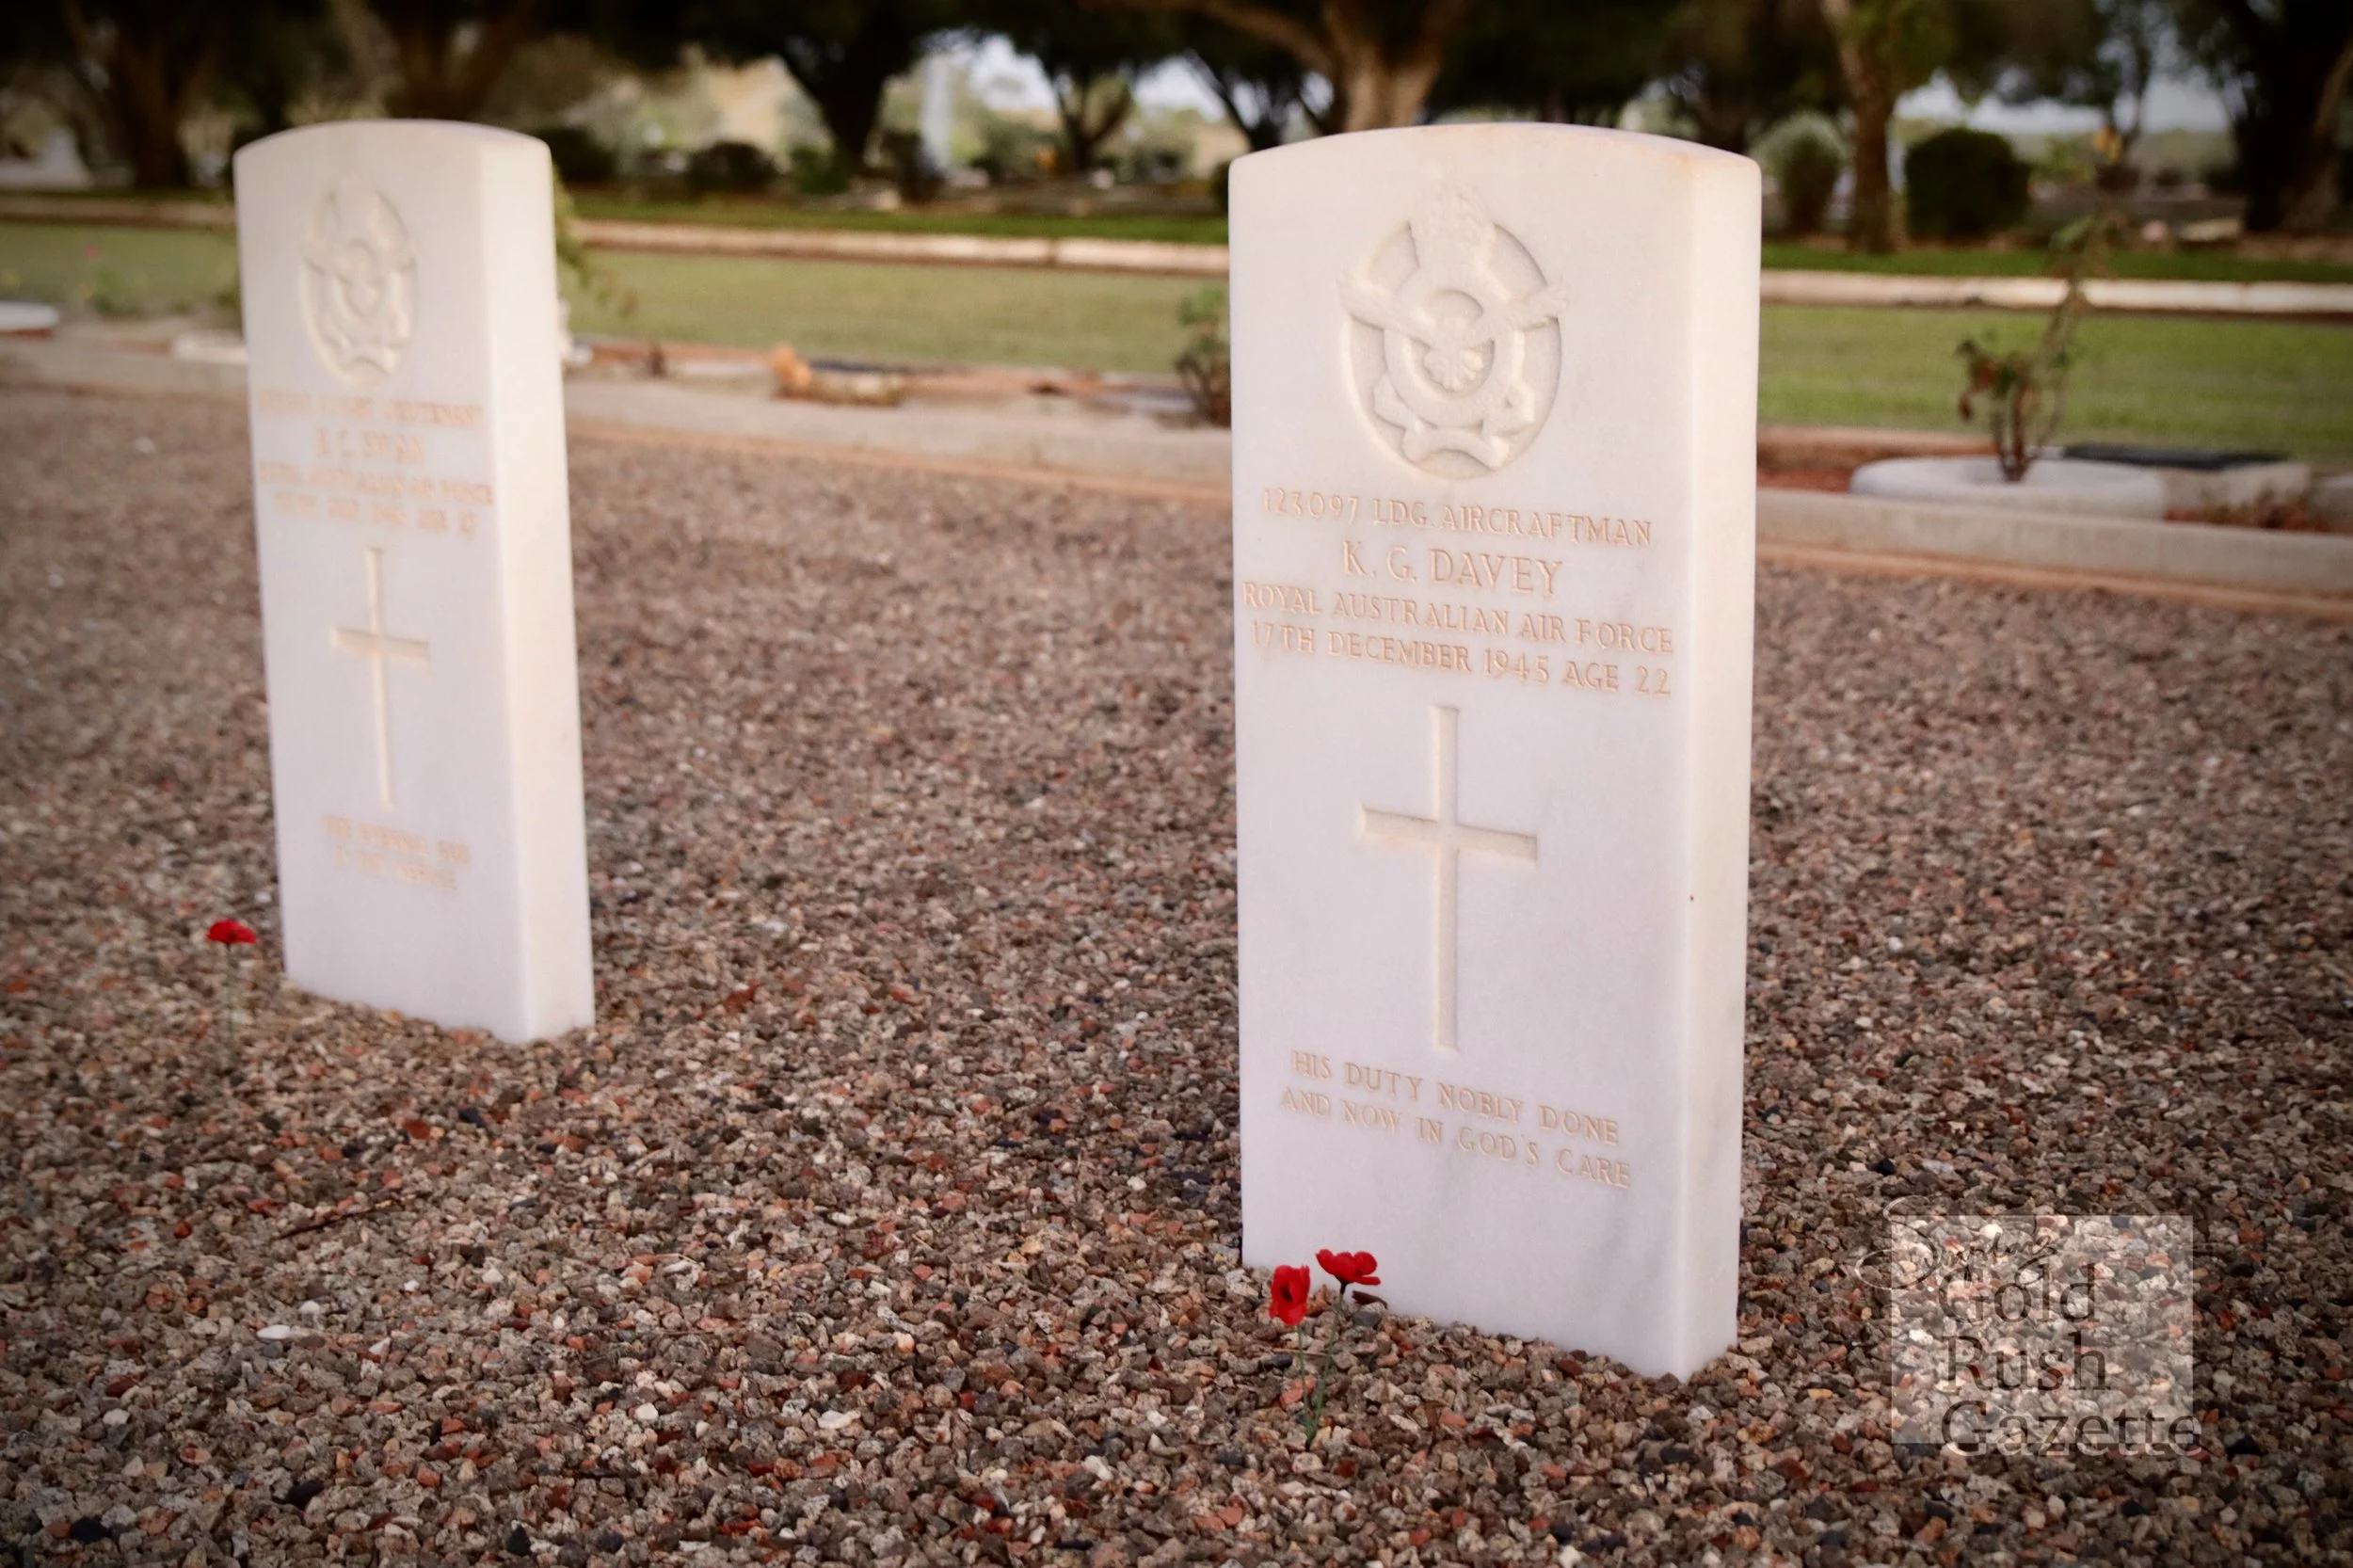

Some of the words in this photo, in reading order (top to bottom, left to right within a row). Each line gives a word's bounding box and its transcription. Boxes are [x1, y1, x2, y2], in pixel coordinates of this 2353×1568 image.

[1262, 487, 1360, 524] 123097
[1441, 504, 1652, 547] AIRCRAFTMAN
[1341, 539, 1378, 577] K.
[1386, 545, 1418, 583] G.
[1429, 548, 1563, 598] DAVEY
[1241, 581, 1322, 615] ROYAL
[1332, 592, 1509, 635] AUSTRALIAN
[1518, 613, 1566, 644] AIR
[1575, 618, 1674, 654] FORCE
[1251, 621, 1316, 654] 17TH
[1326, 631, 1472, 675] DECEMBER
[1483, 648, 1550, 685] 1945
[1561, 661, 1620, 692] AGE
[1635, 664, 1672, 696] 22
[1290, 1048, 1333, 1080] HIS
[1342, 1061, 1424, 1103] DUTY
[1436, 1081, 1526, 1125] NOBLY
[1537, 1103, 1621, 1146] DONE
[1279, 1084, 1333, 1119] AND
[1338, 1097, 1403, 1133] NOW
[1415, 1115, 1445, 1147] IN
[1455, 1126, 1541, 1170] GOD'S
[1555, 1147, 1632, 1190] CARE
